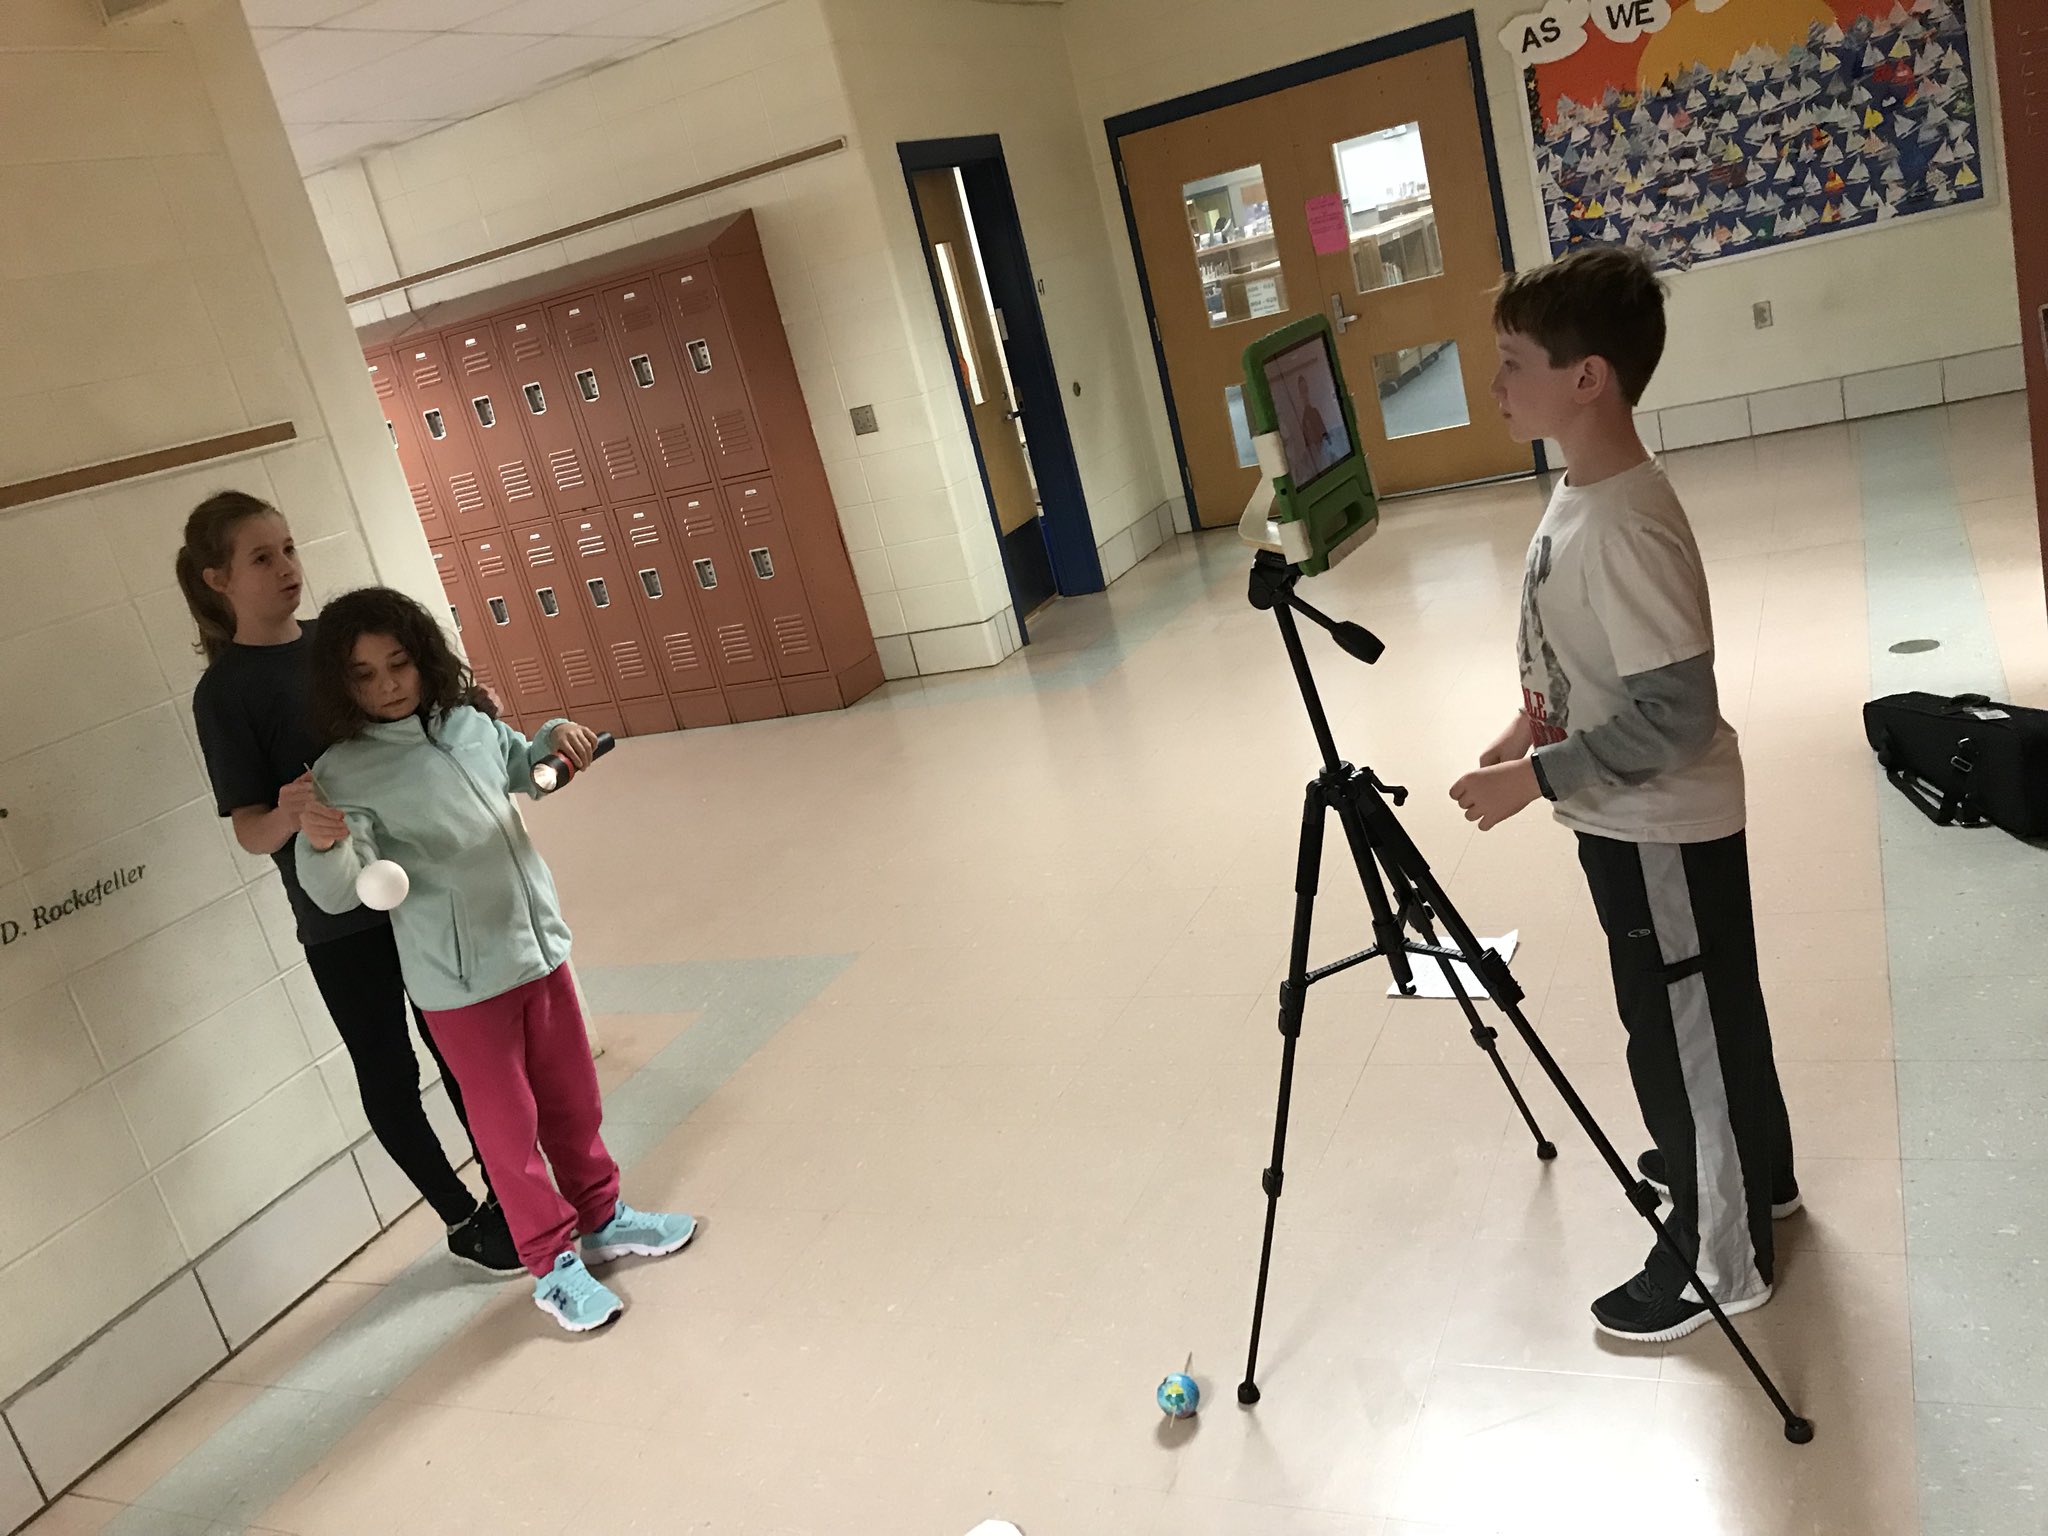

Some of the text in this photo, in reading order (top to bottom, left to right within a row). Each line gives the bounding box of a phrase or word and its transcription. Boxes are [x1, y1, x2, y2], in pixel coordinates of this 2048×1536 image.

[1521, 0, 1655, 53] AS WE
[0, 864, 147, 945] D. Rockefeller
